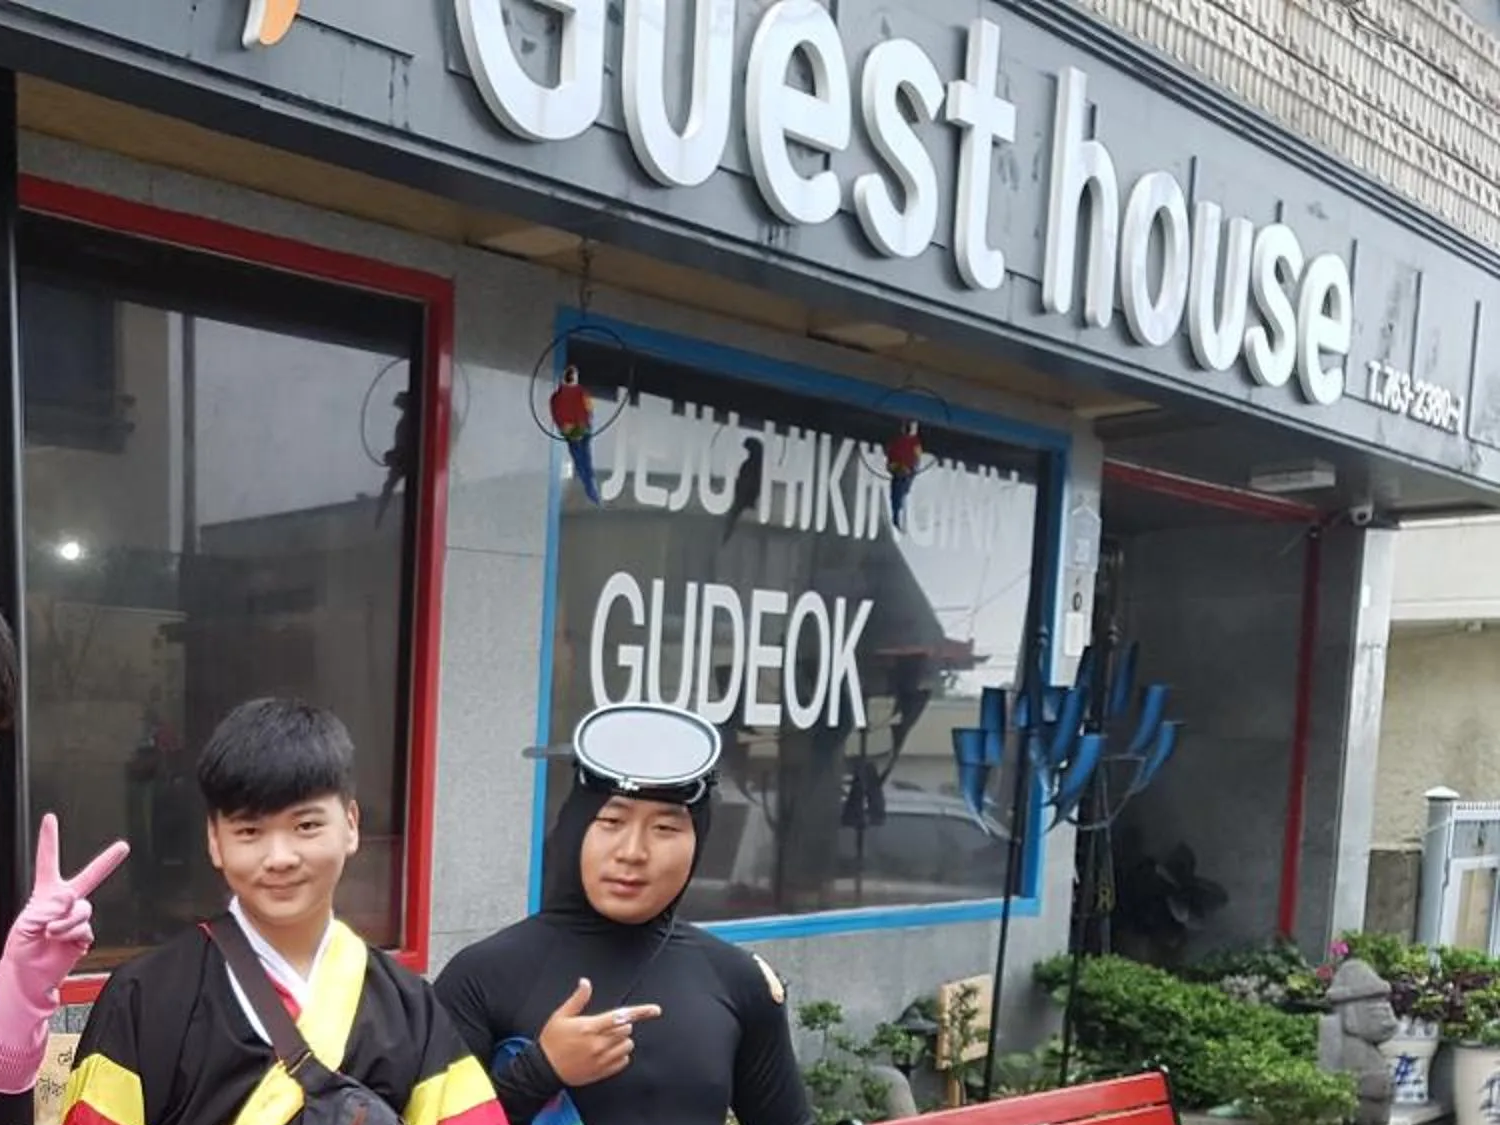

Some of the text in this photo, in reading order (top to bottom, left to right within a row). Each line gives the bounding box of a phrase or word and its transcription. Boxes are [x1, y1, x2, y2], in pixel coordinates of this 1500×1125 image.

[1042, 66, 1351, 406] house
[601, 386, 740, 515] JEJU
[590, 570, 874, 729] GUDEOK
